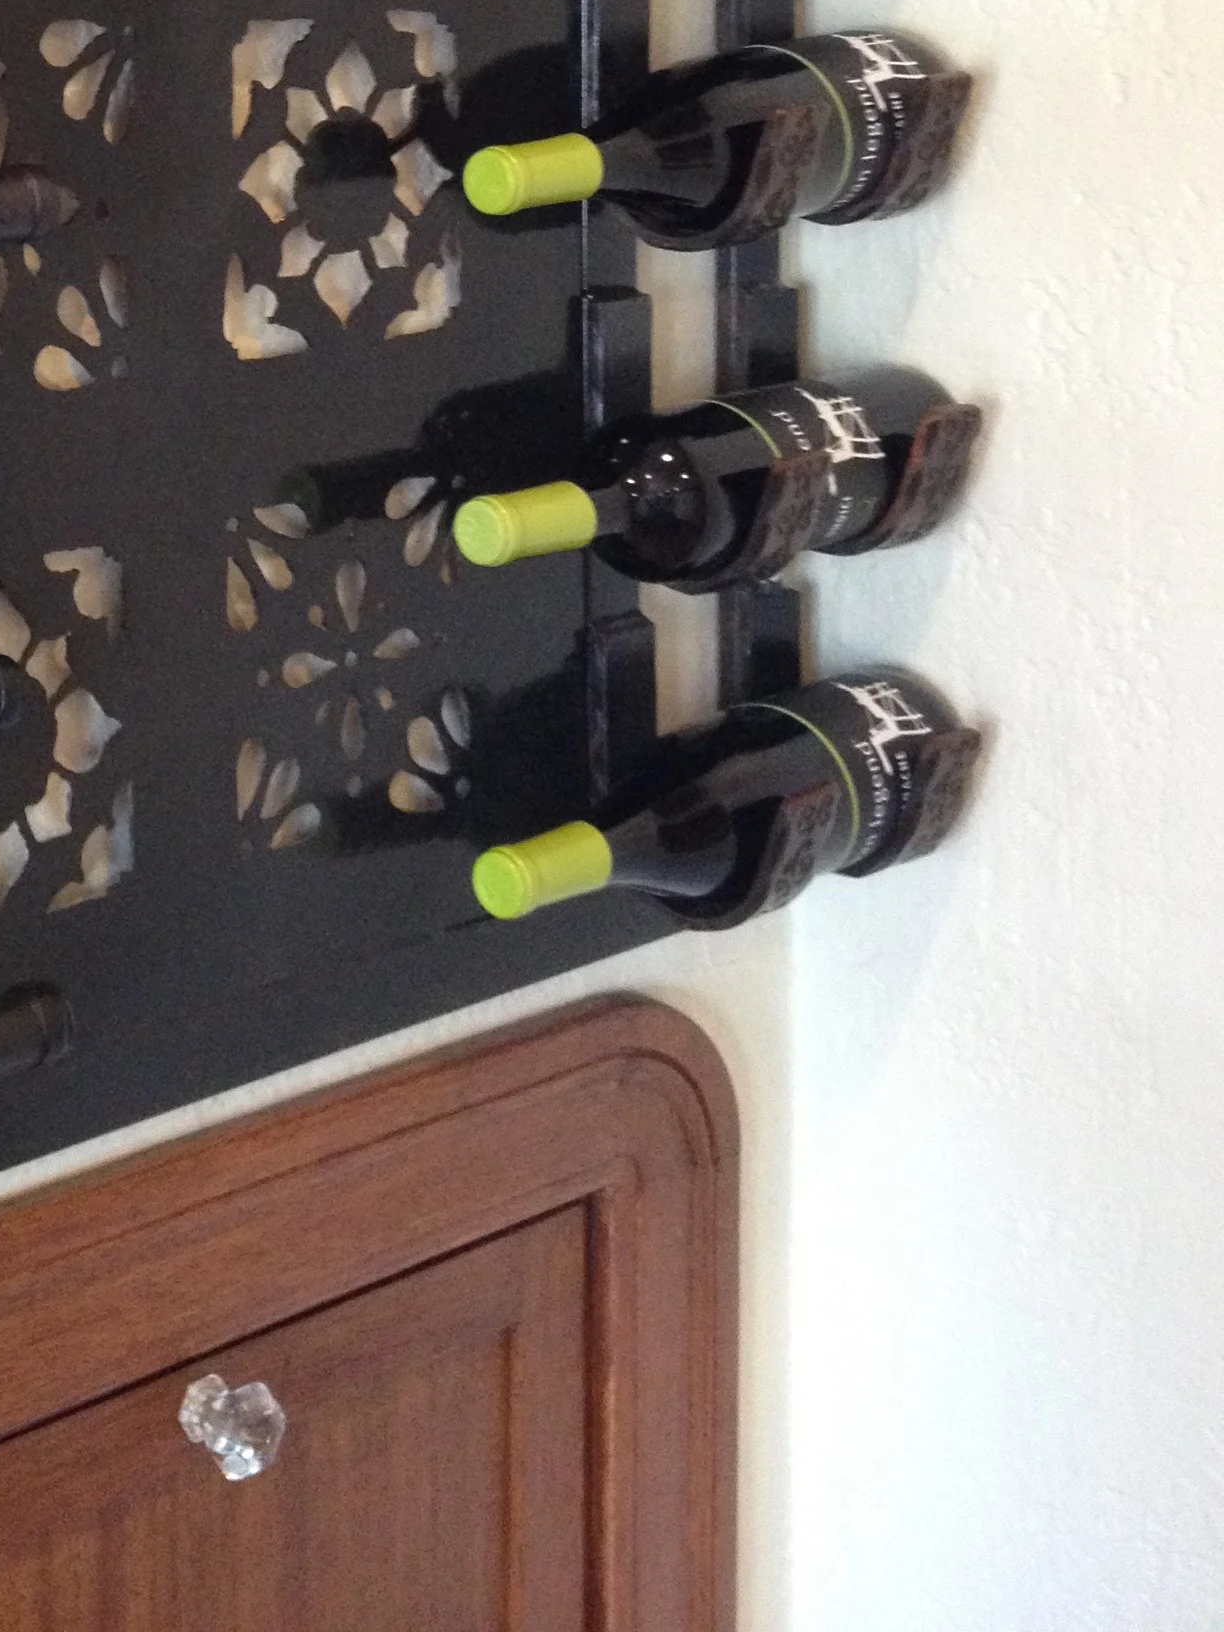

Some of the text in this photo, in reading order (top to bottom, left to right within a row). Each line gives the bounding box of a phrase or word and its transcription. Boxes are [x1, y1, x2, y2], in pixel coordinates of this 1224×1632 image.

[846, 77, 885, 160] legend
[770, 410, 812, 451] end
[853, 741, 890, 828] legend
